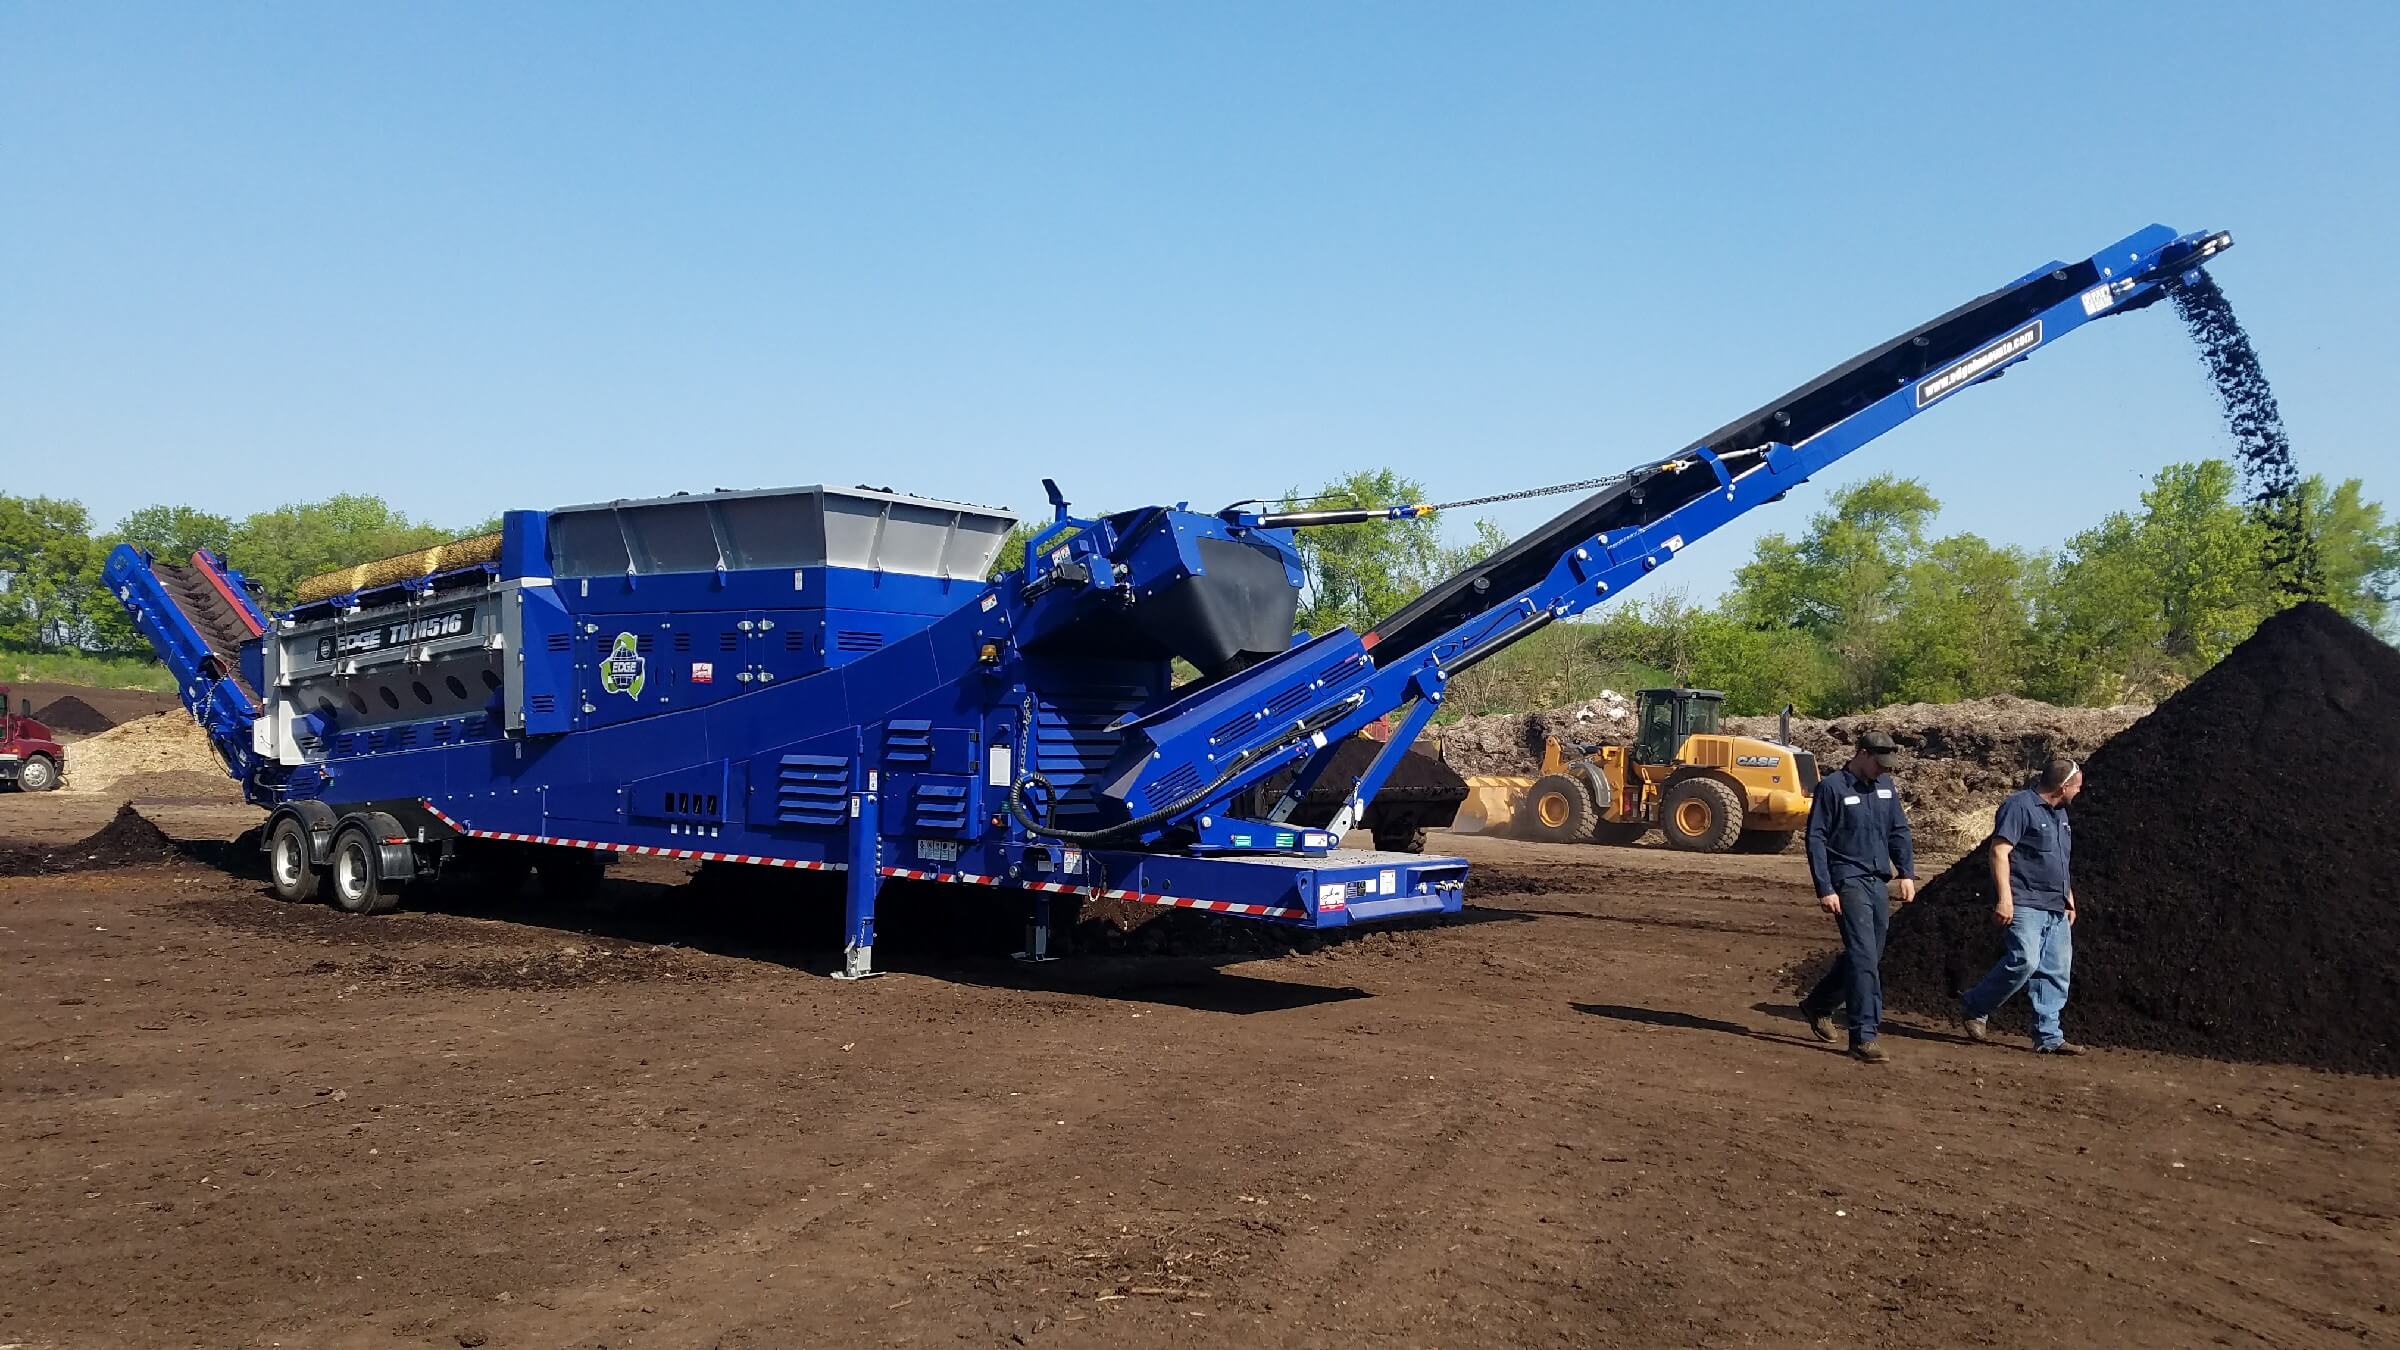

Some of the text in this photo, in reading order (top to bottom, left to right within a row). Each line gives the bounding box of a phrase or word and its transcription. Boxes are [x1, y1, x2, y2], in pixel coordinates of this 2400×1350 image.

[337, 613, 462, 650] EDGE TRM516
[612, 661, 637, 673] EDGE
[1736, 755, 1780, 767] CASE
